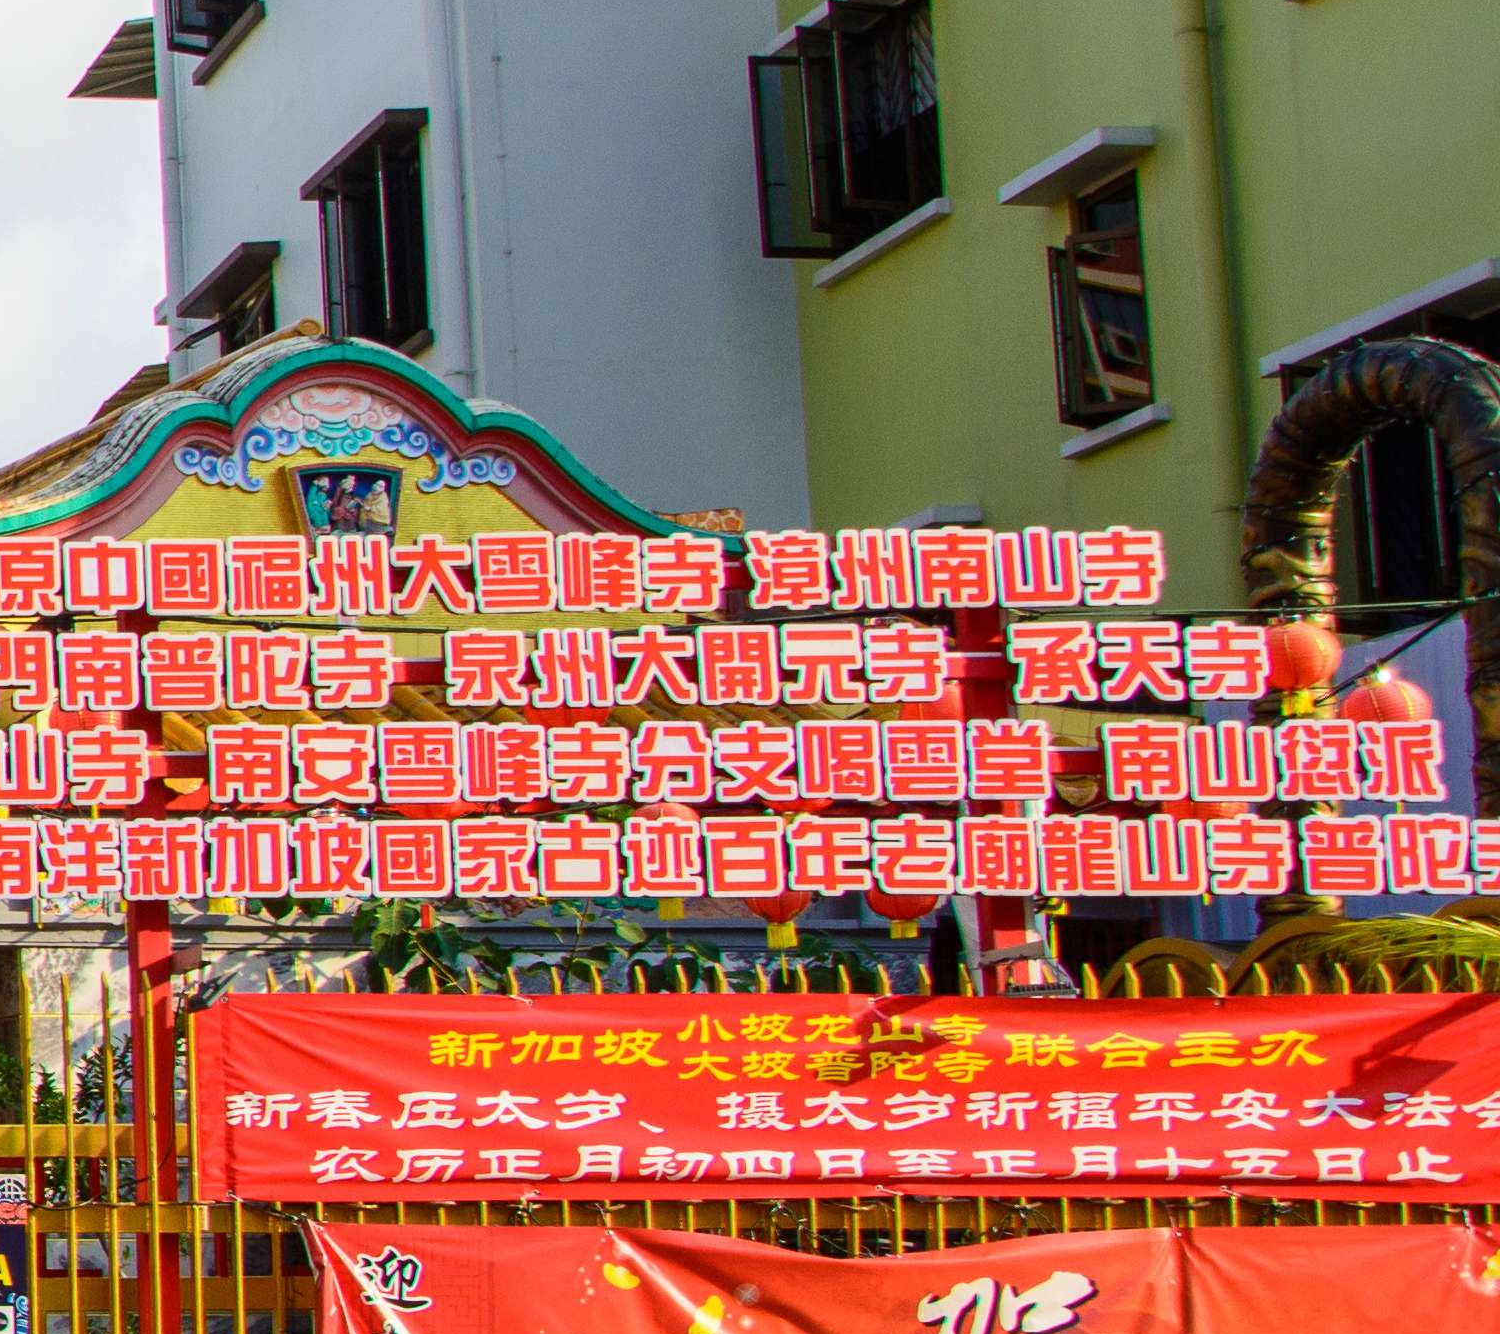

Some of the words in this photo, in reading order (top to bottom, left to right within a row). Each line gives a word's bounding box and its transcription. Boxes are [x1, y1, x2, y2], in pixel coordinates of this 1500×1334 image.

[748, 527, 1165, 608] 漳州南山寺
[445, 622, 947, 708] 泉州大開元寺
[1007, 620, 1272, 703] 承天寺
[206, 719, 1051, 805] 南安雪峰寺分支喝雲堂
[429, 1028, 668, 1070] 新加坡
[676, 1013, 989, 1046] 小坡龙山寺
[1004, 1028, 1327, 1069] 联合主办
[677, 1048, 994, 1084] 大坡普陀寺
[308, 1143, 1464, 1184] 农历正月初四日至正月十五日止
